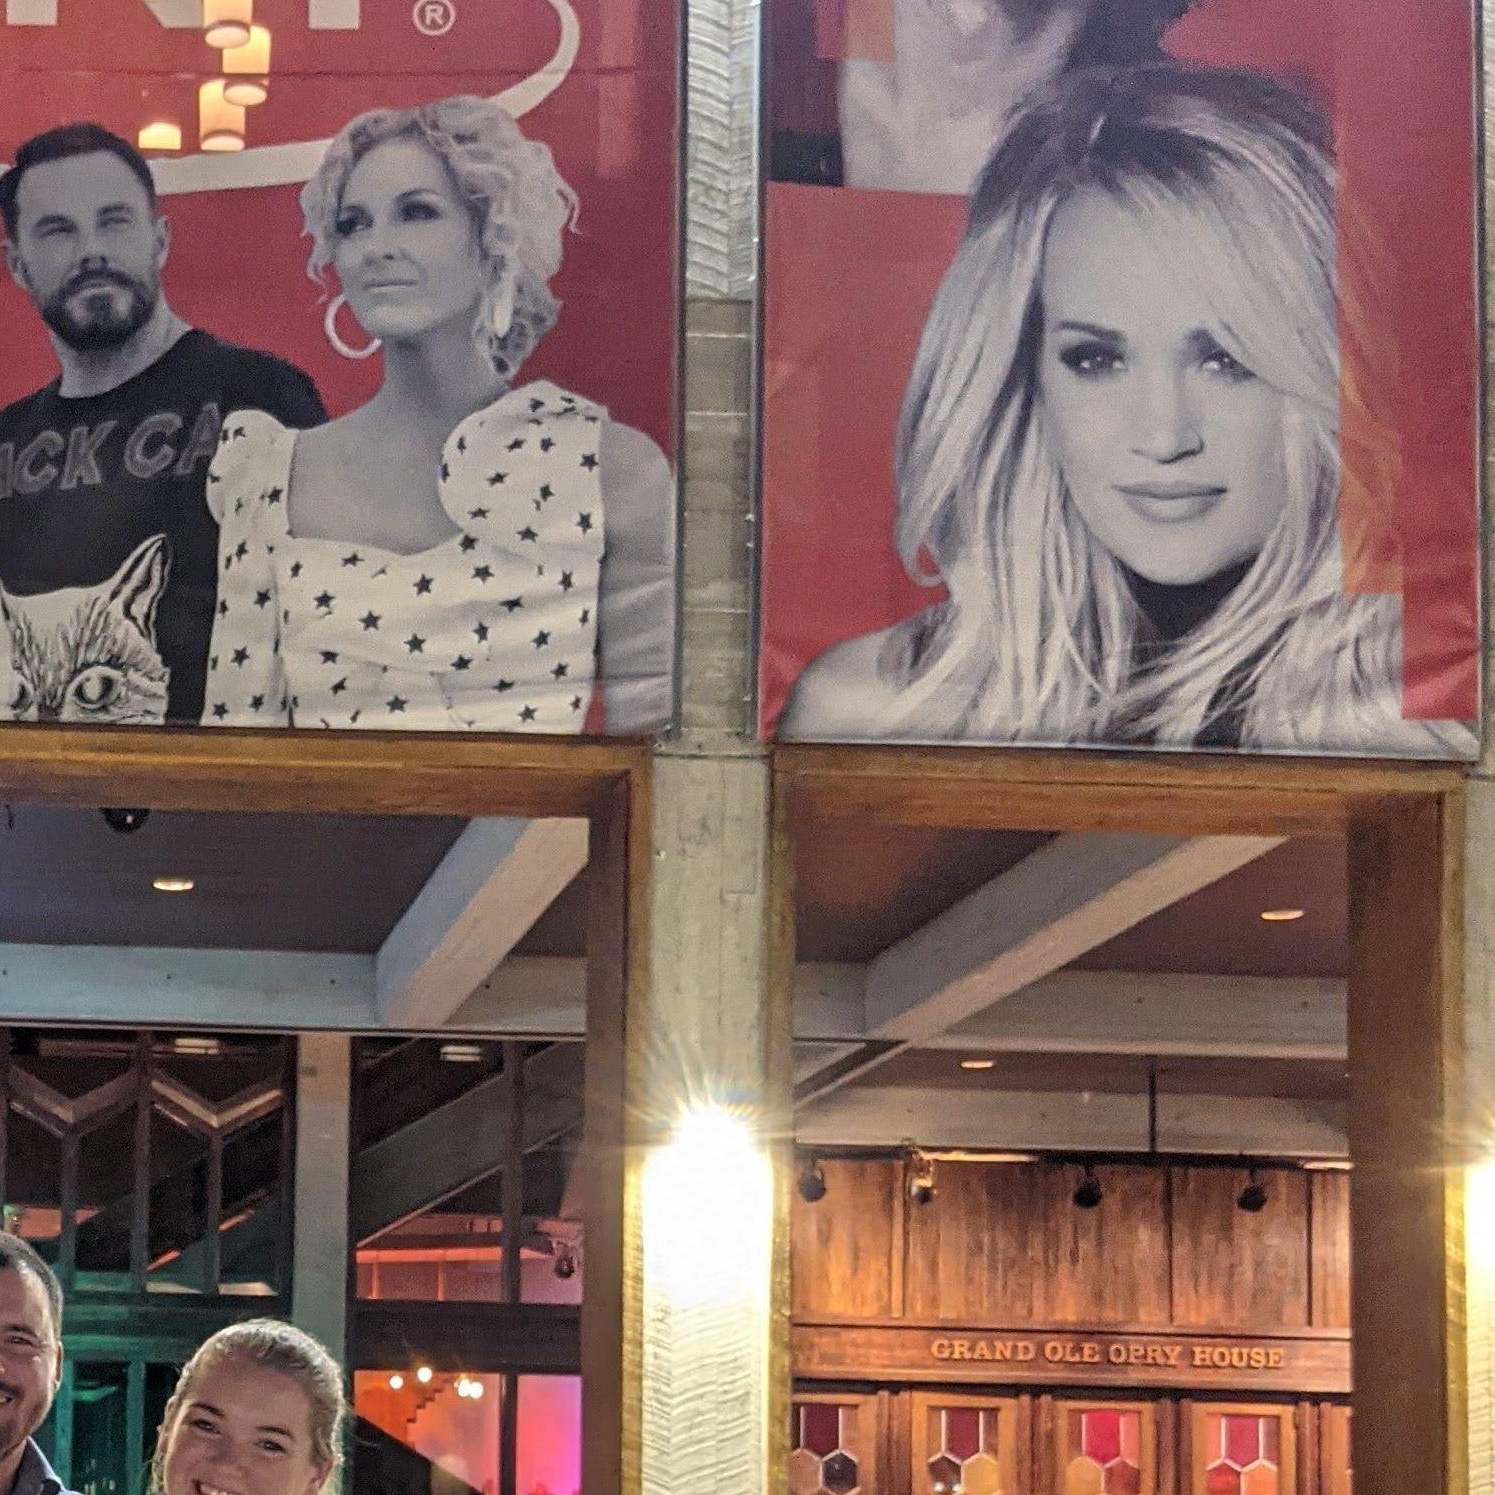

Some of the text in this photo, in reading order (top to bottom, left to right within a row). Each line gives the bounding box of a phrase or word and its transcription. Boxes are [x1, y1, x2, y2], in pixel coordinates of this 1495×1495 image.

[123, 401, 221, 479] CA
[931, 1338, 1285, 1369] GRAND OLE OPRY HOUSE
